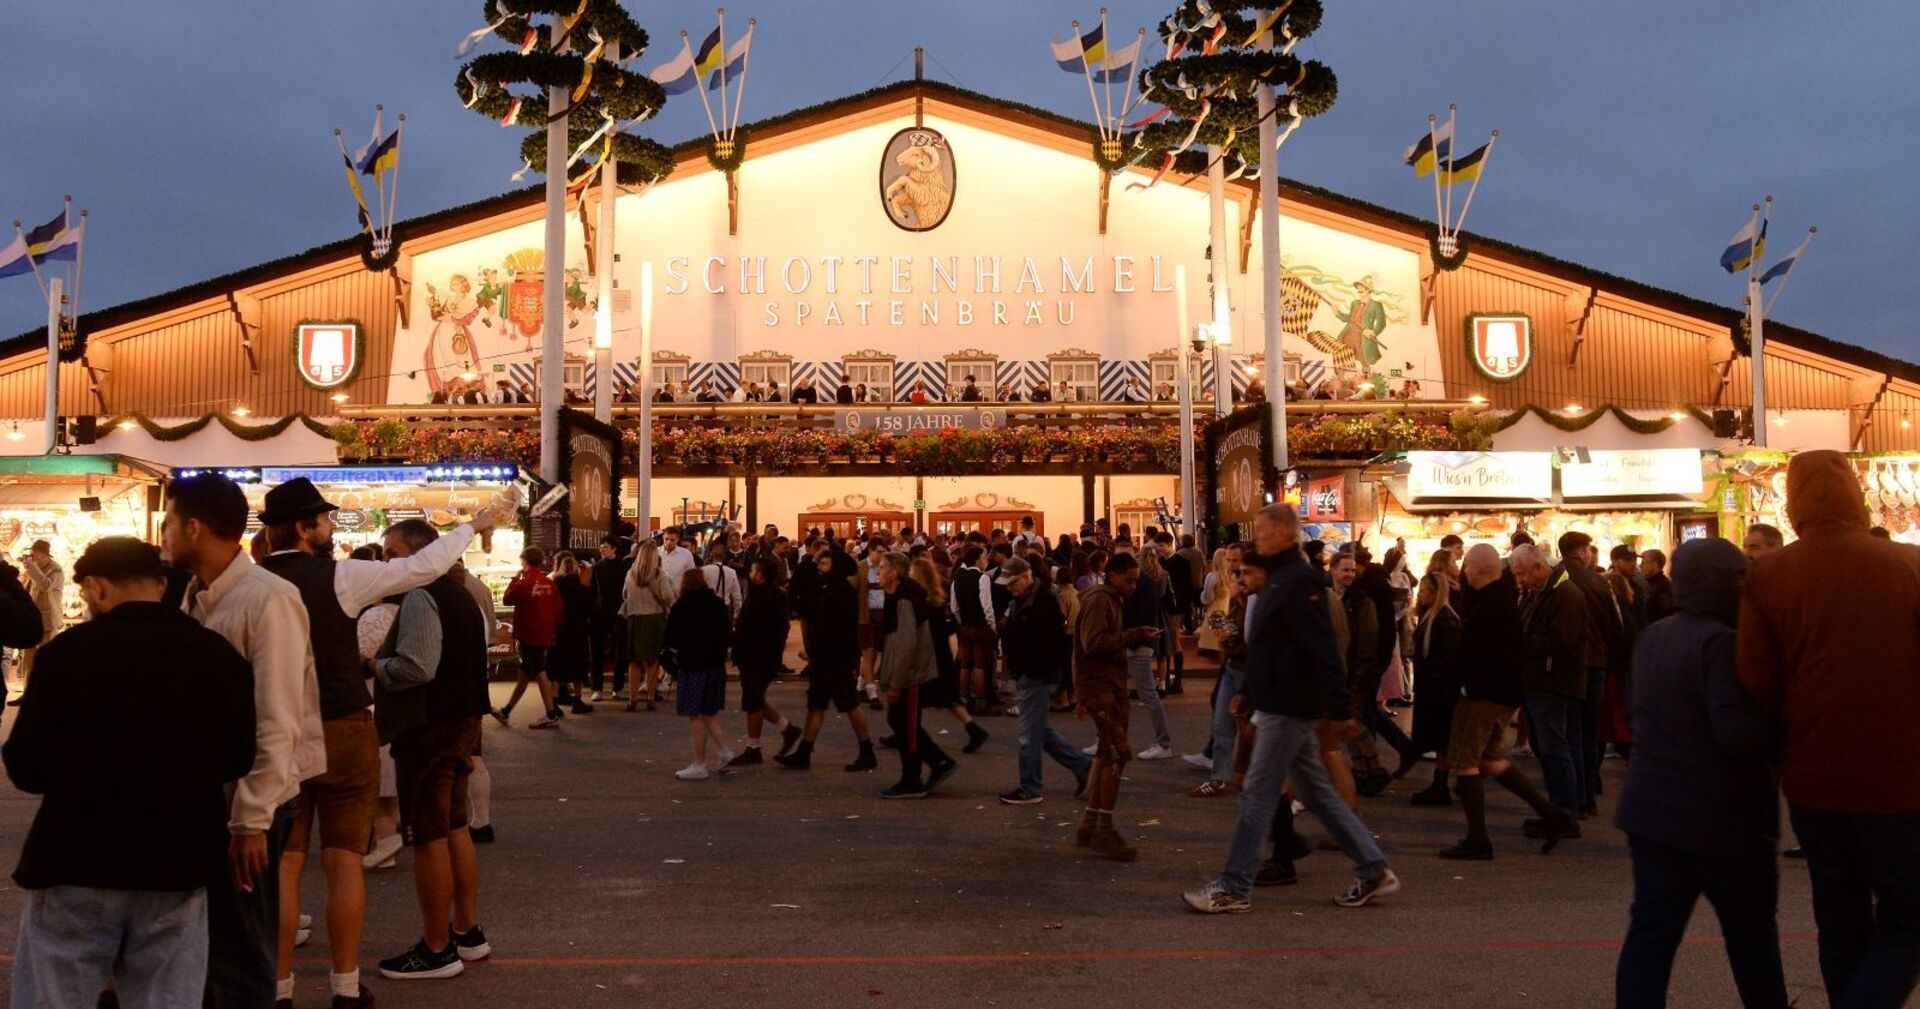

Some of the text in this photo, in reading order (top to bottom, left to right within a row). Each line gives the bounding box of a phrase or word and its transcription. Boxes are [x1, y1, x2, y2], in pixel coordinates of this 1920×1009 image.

[665, 255, 1174, 294] SCHOTTENHAMEL
[763, 301, 1074, 326] SPATENBRÄU
[874, 414, 964, 432] 158 JAHRE
[569, 527, 609, 549] FESTHAL
